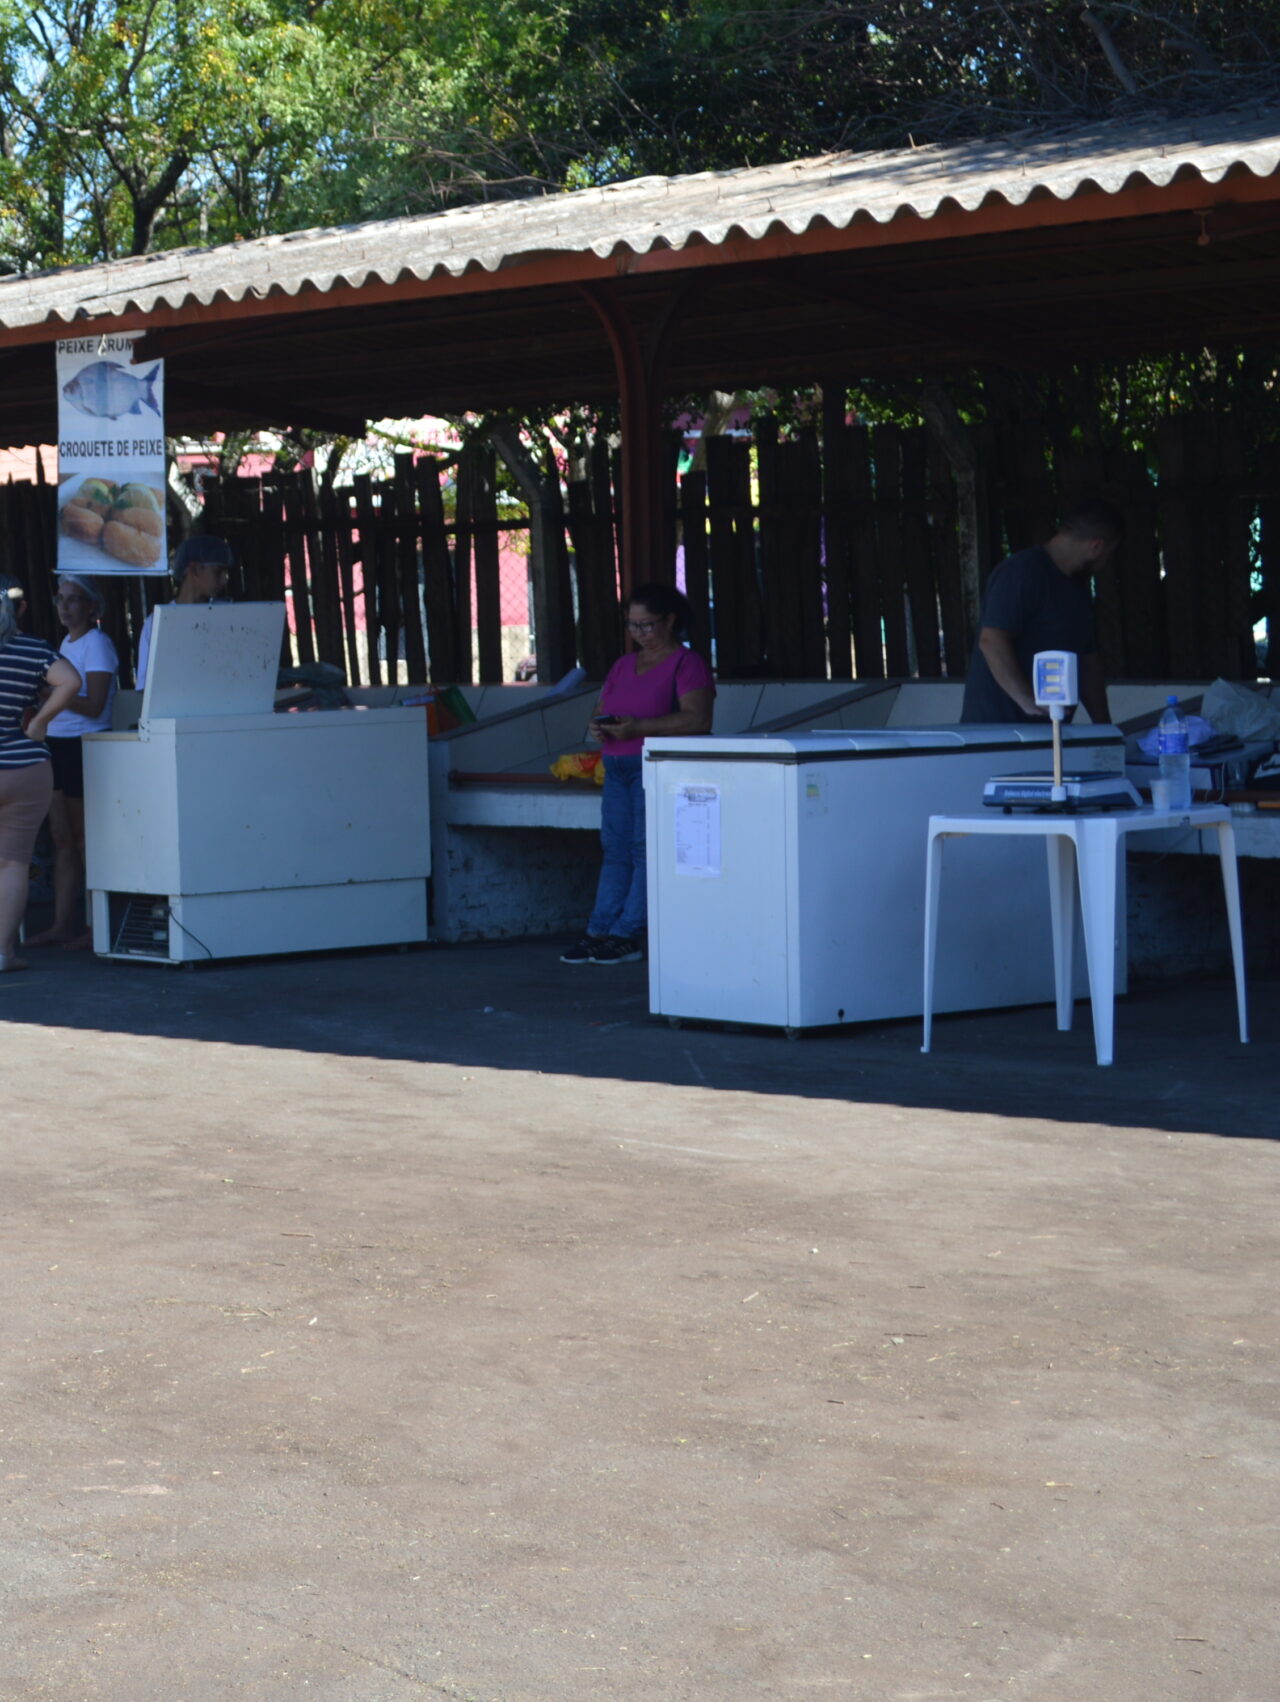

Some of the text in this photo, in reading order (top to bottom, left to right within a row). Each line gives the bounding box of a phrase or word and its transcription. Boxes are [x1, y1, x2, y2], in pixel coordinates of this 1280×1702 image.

[58, 340, 94, 354] PEIXE
[60, 440, 162, 457] CROQUETE DE PEIXE
